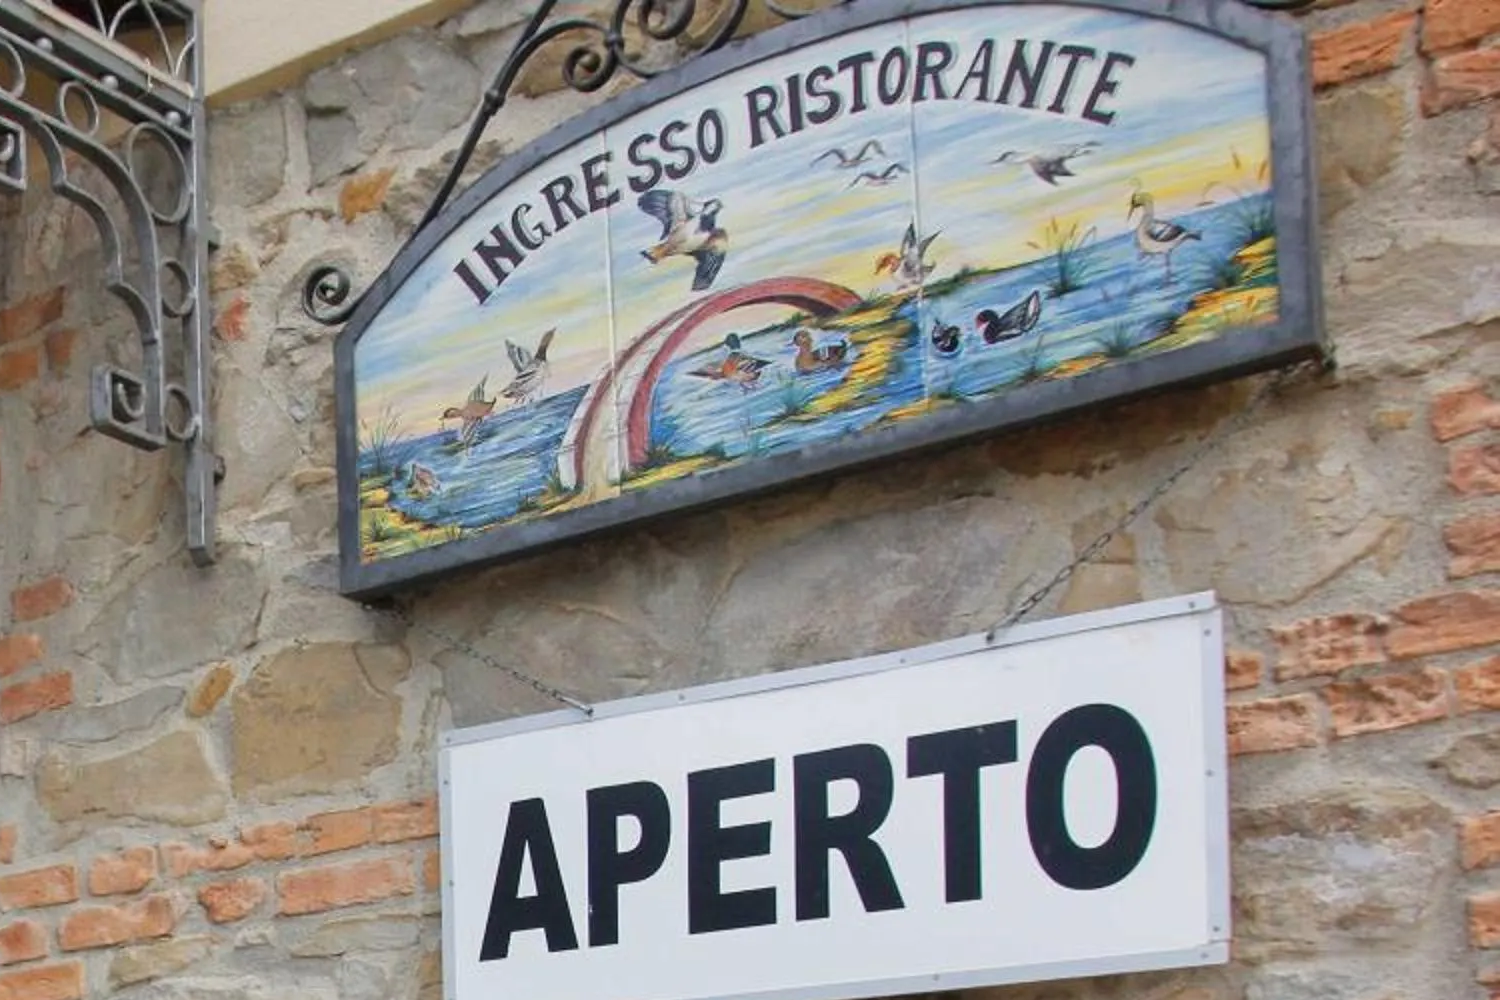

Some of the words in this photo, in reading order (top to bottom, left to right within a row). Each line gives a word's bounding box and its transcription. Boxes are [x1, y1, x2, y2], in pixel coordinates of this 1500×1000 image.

[451, 107, 725, 306] INGRESSO
[746, 39, 1136, 148] RISTORANTE
[478, 702, 1158, 963] APERTO
